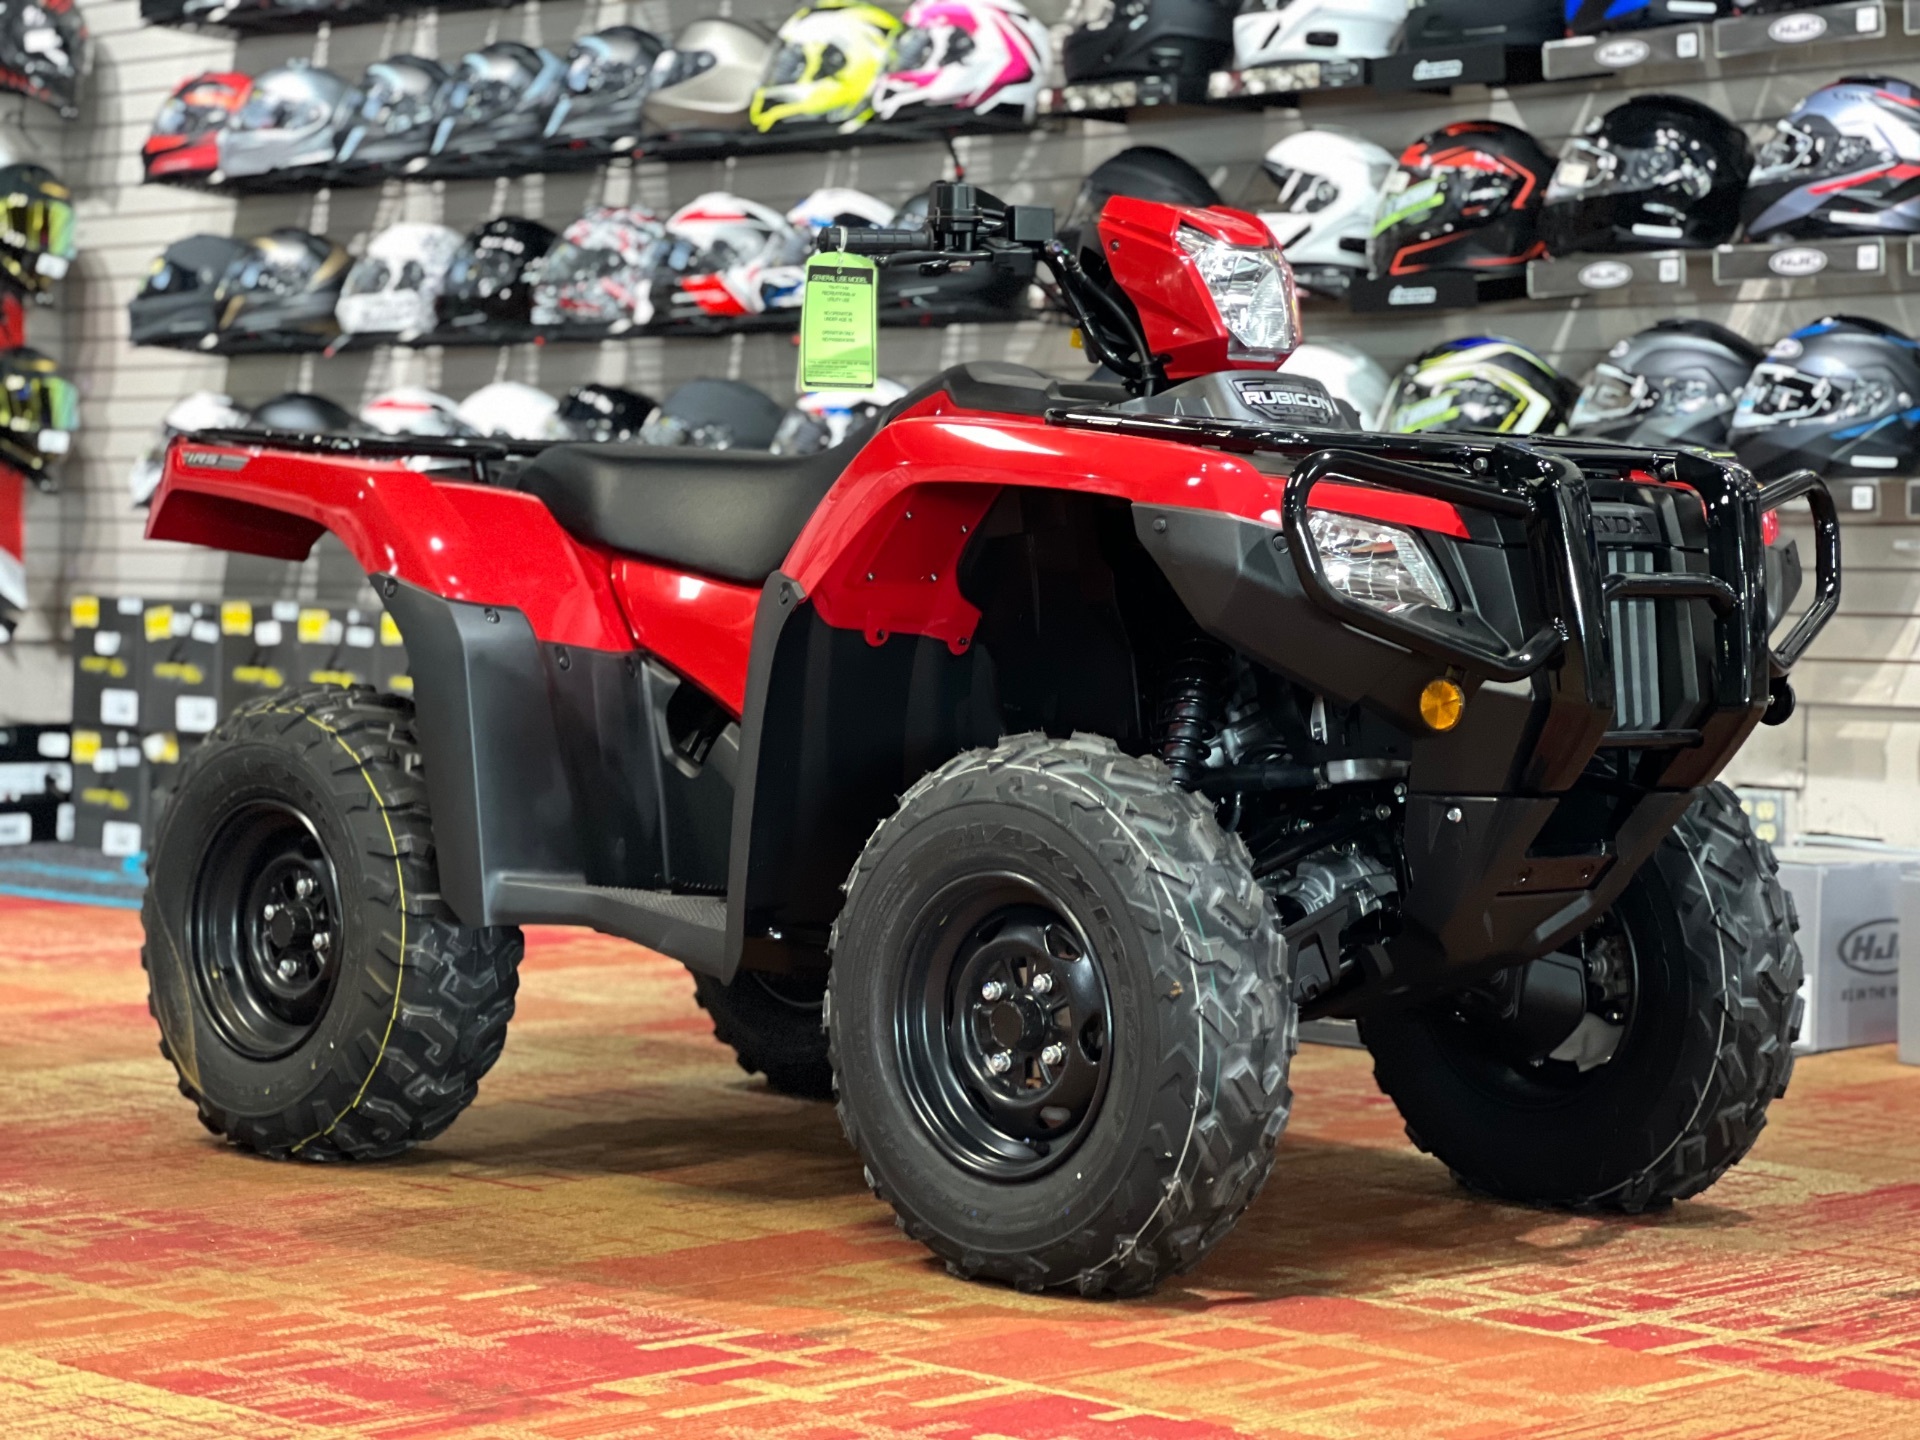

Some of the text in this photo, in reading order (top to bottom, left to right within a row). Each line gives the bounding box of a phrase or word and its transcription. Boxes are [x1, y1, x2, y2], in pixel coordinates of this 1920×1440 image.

[811, 274, 835, 282] GENERAL
[847, 275, 868, 283] MODEL
[1241, 390, 1334, 416] RUBICON
[187, 452, 219, 465] IRS
[1593, 515, 1652, 535] NDA
[946, 821, 1128, 964] MAXXIS
[1850, 933, 1899, 961] HJ
